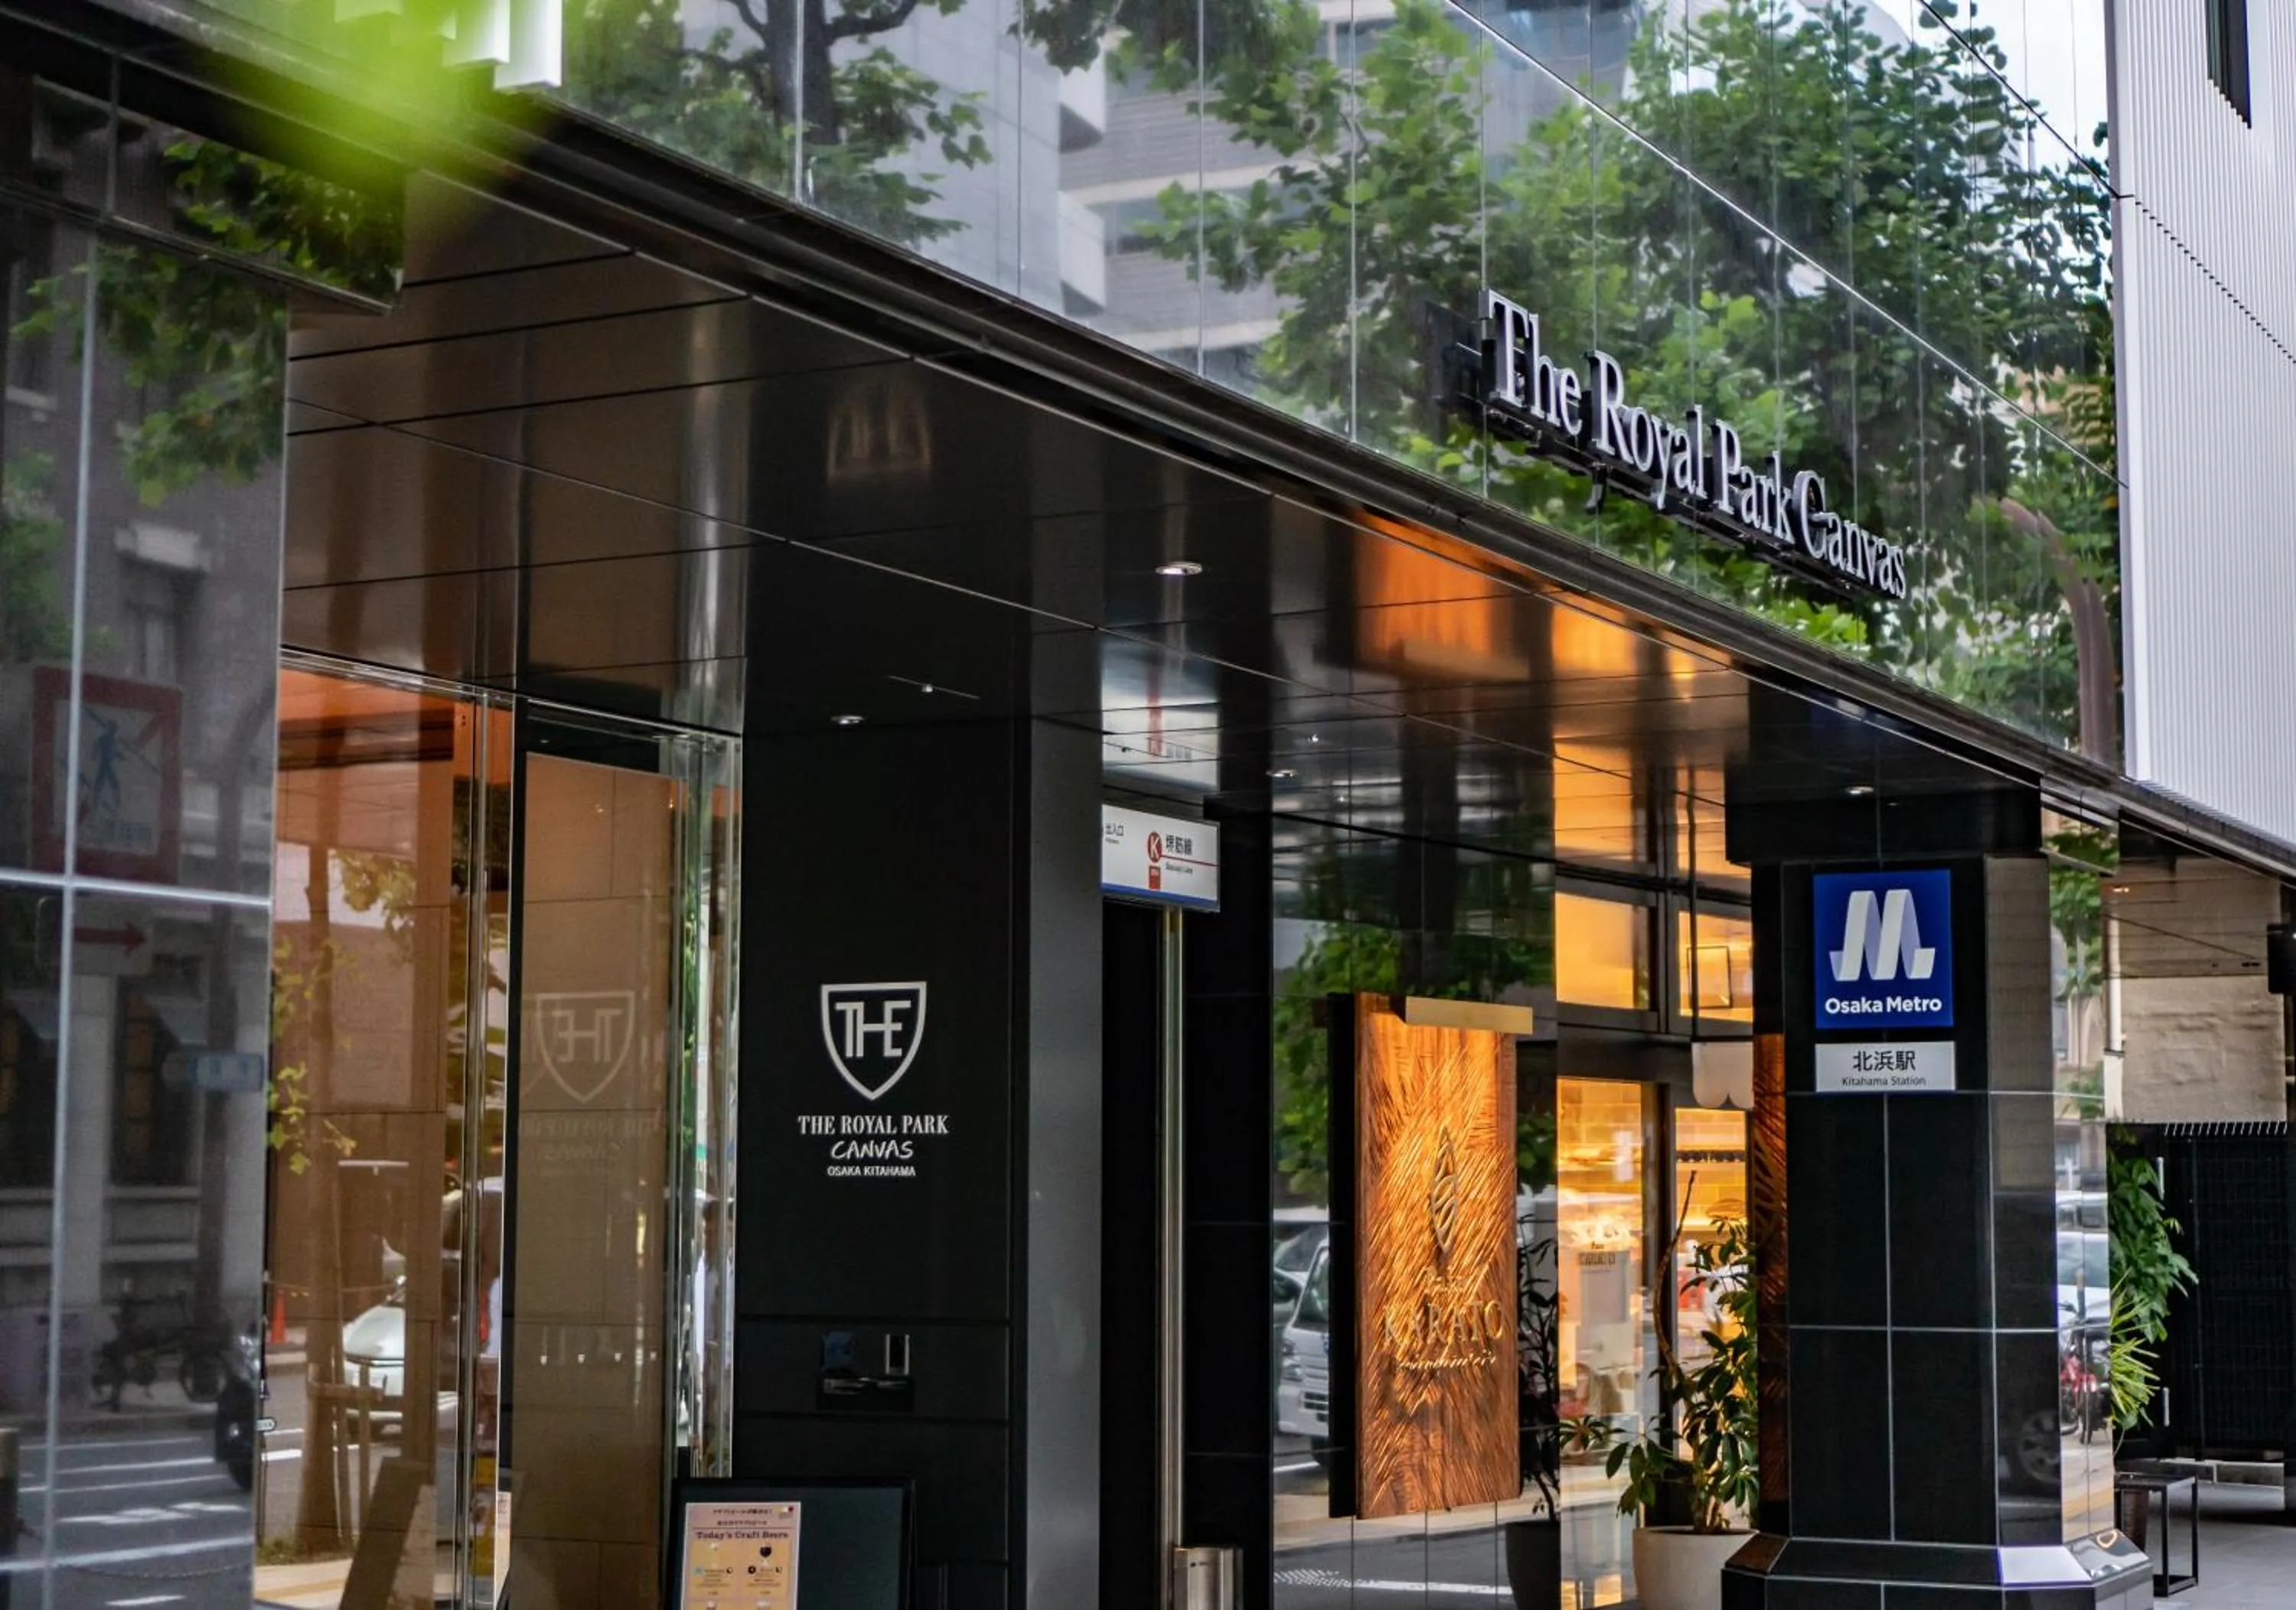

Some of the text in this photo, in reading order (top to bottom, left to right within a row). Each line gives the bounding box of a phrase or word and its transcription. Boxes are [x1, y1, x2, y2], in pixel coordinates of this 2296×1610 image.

[1480, 288, 1906, 600] The Royal Park Canvas
[1825, 996, 1942, 1014] Osaka Metro
[835, 1000, 912, 1058] THE
[1853, 1050, 1916, 1072] 北浜駅
[1842, 1075, 1926, 1087] Kitahama Station
[797, 1115, 950, 1135] THE ROYAL PARK
[830, 1139, 914, 1160] CANVAS
[827, 1165, 916, 1177] OSAKA KITAHAMA
[696, 1531, 732, 1540] Today's
[735, 1530, 760, 1539] Craft
